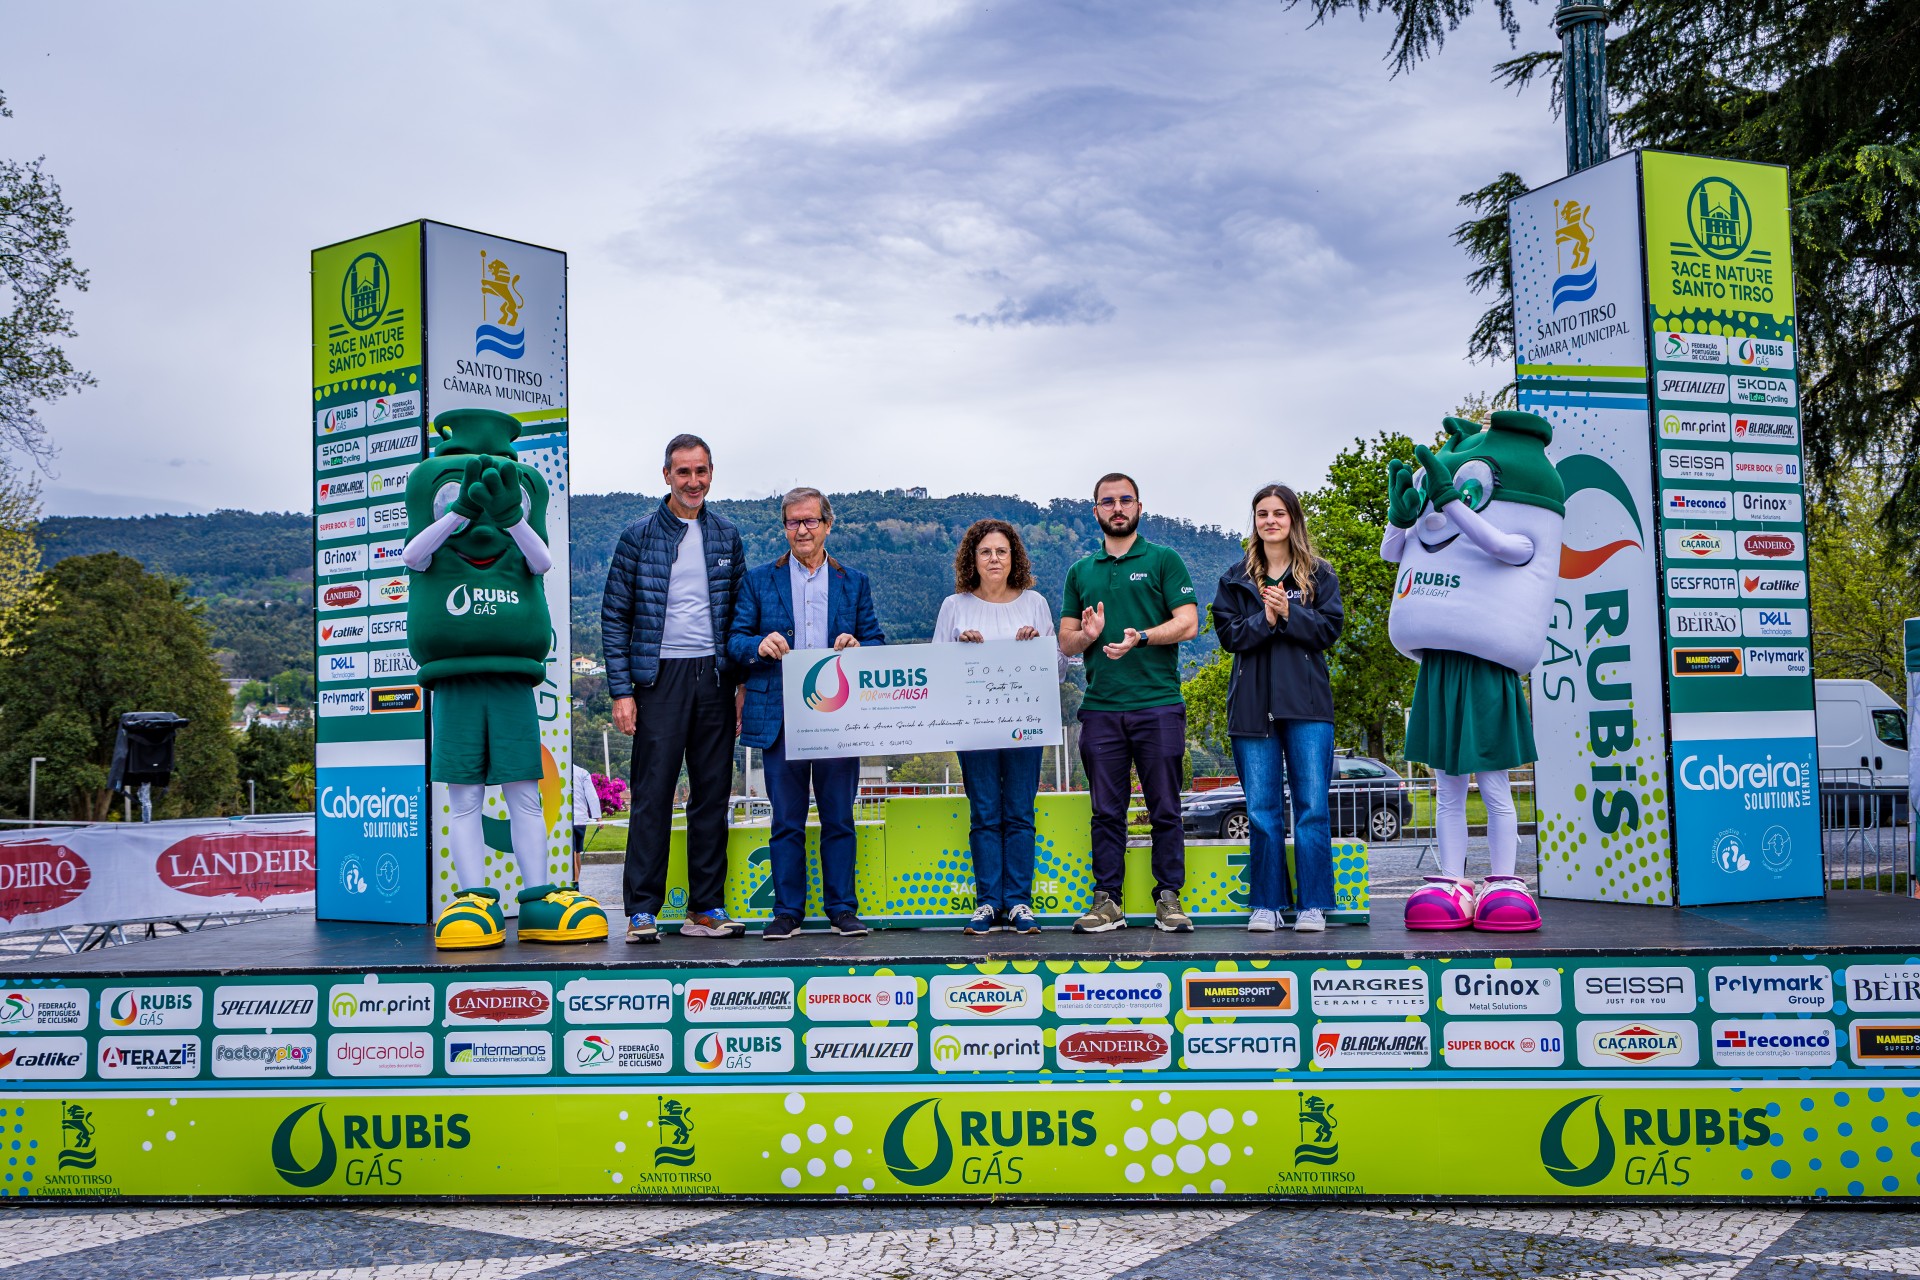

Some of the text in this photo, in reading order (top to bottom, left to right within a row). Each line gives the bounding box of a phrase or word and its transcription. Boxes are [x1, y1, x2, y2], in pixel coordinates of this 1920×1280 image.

[1671, 261, 1772, 284] RACE NATURE
[1672, 279, 1773, 302] SANTO TIRSO
[1538, 302, 1616, 340] SANTO TIRSO
[329, 326, 404, 356] RACE NATURE
[1528, 322, 1630, 362] CÂMARA MUNICIPAL
[329, 344, 404, 374] SANTO TIRSO
[1756, 356, 1769, 366] GÁS
[457, 360, 542, 387] SANTO TIRSO
[444, 378, 554, 406] CÂMARA MUNICIPAL
[1661, 380, 1725, 394] SPECIALIZED
[370, 435, 418, 454] SPECIALIZED
[1669, 455, 1724, 470] SEISSA
[1786, 464, 1796, 474] 0.0
[1686, 499, 1726, 509] reconco
[1743, 494, 1786, 510] Brinox
[1681, 540, 1720, 549] CAÇAROLA
[1747, 540, 1792, 549] LANDEIRO
[324, 551, 356, 565] Brinox
[1671, 577, 1735, 590] GESFROTA
[1760, 580, 1799, 591] catlike
[326, 590, 359, 600] LANDEIRO
[1411, 587, 1450, 598] GÁS LIGHT
[474, 603, 497, 615] GÁS
[1677, 615, 1736, 632] BEIRÃO
[1760, 612, 1791, 625] DELL
[333, 627, 363, 638] catlike
[1542, 598, 1582, 703] GÁS
[1750, 650, 1804, 664] Polymark
[331, 657, 354, 670] DELL
[374, 655, 418, 673] BEIRÃO
[859, 668, 928, 688] RUBiS
[323, 692, 364, 705] Polymark
[860, 690, 878, 701] POR
[892, 688, 928, 700] CAUSA
[1680, 754, 1800, 791] Cabreira
[1801, 762, 1810, 806] EVENTOS
[321, 786, 409, 818] Cabreira
[1744, 791, 1800, 810] SOLUTIONS
[364, 822, 408, 838] SOLUTIONS
[168, 849, 315, 878] LANDEIR
[245, 882, 270, 892] 1977
[1204, 987, 1271, 996] NAMEDSPORT
[1314, 979, 1424, 991] MARGRES
[1455, 974, 1539, 995] Brinox
[1586, 976, 1684, 994] SEISSA
[1716, 975, 1823, 995] Polymark
[140, 994, 192, 1010] RUBiS
[710, 990, 790, 1006] BLACKJACK
[808, 991, 914, 1005] SUPER BOCK 0.0
[950, 990, 1024, 1005] CAÇAROLA
[1087, 989, 1162, 1000] reconco
[1789, 996, 1824, 1006] Group
[38, 1002, 76, 1010] FEDERAÇÃO
[217, 999, 314, 1016] SPECIALIZED
[359, 996, 430, 1014] mr.print
[456, 996, 542, 1009] LANDEIRO
[569, 995, 670, 1011] GESFROTA
[139, 1011, 164, 1026] GÁS
[619, 1044, 659, 1052] FEDERAÇÃO
[727, 1036, 781, 1052] RUBiS
[1067, 1040, 1159, 1052] LANDEIRO
[1188, 1036, 1296, 1054] GESFROTA
[1342, 1036, 1425, 1051] BLACKJACK
[1448, 1037, 1560, 1052] SUPER BOCK 0.0
[1598, 1037, 1677, 1053] CAÇAROLA
[1748, 1036, 1829, 1047] reconco
[216, 1044, 312, 1064] factoryplay
[473, 1043, 546, 1057] Intermanos
[810, 1042, 914, 1058] SPECIALIZED
[963, 1041, 1040, 1059] mr.print
[16, 1053, 79, 1066] catlike
[726, 1054, 752, 1069] GÁS
[344, 1113, 471, 1150] RUBiS
[961, 1110, 1097, 1147] RUBiS
[1624, 1108, 1772, 1147] RUBiS
[346, 1151, 402, 1186] GÁS
[961, 1150, 1024, 1185] GÁS
[1624, 1150, 1692, 1187] GÁS
[45, 1175, 112, 1185] SANTO TIRSO
[640, 1172, 711, 1183] SANTO TIRSO
[1278, 1171, 1355, 1182] SANTO TIRSO
[36, 1186, 72, 1196] CÂMARA
[631, 1184, 668, 1194] CÂMARA
[1267, 1183, 1366, 1194] CÂMARA MUNICIPAL
